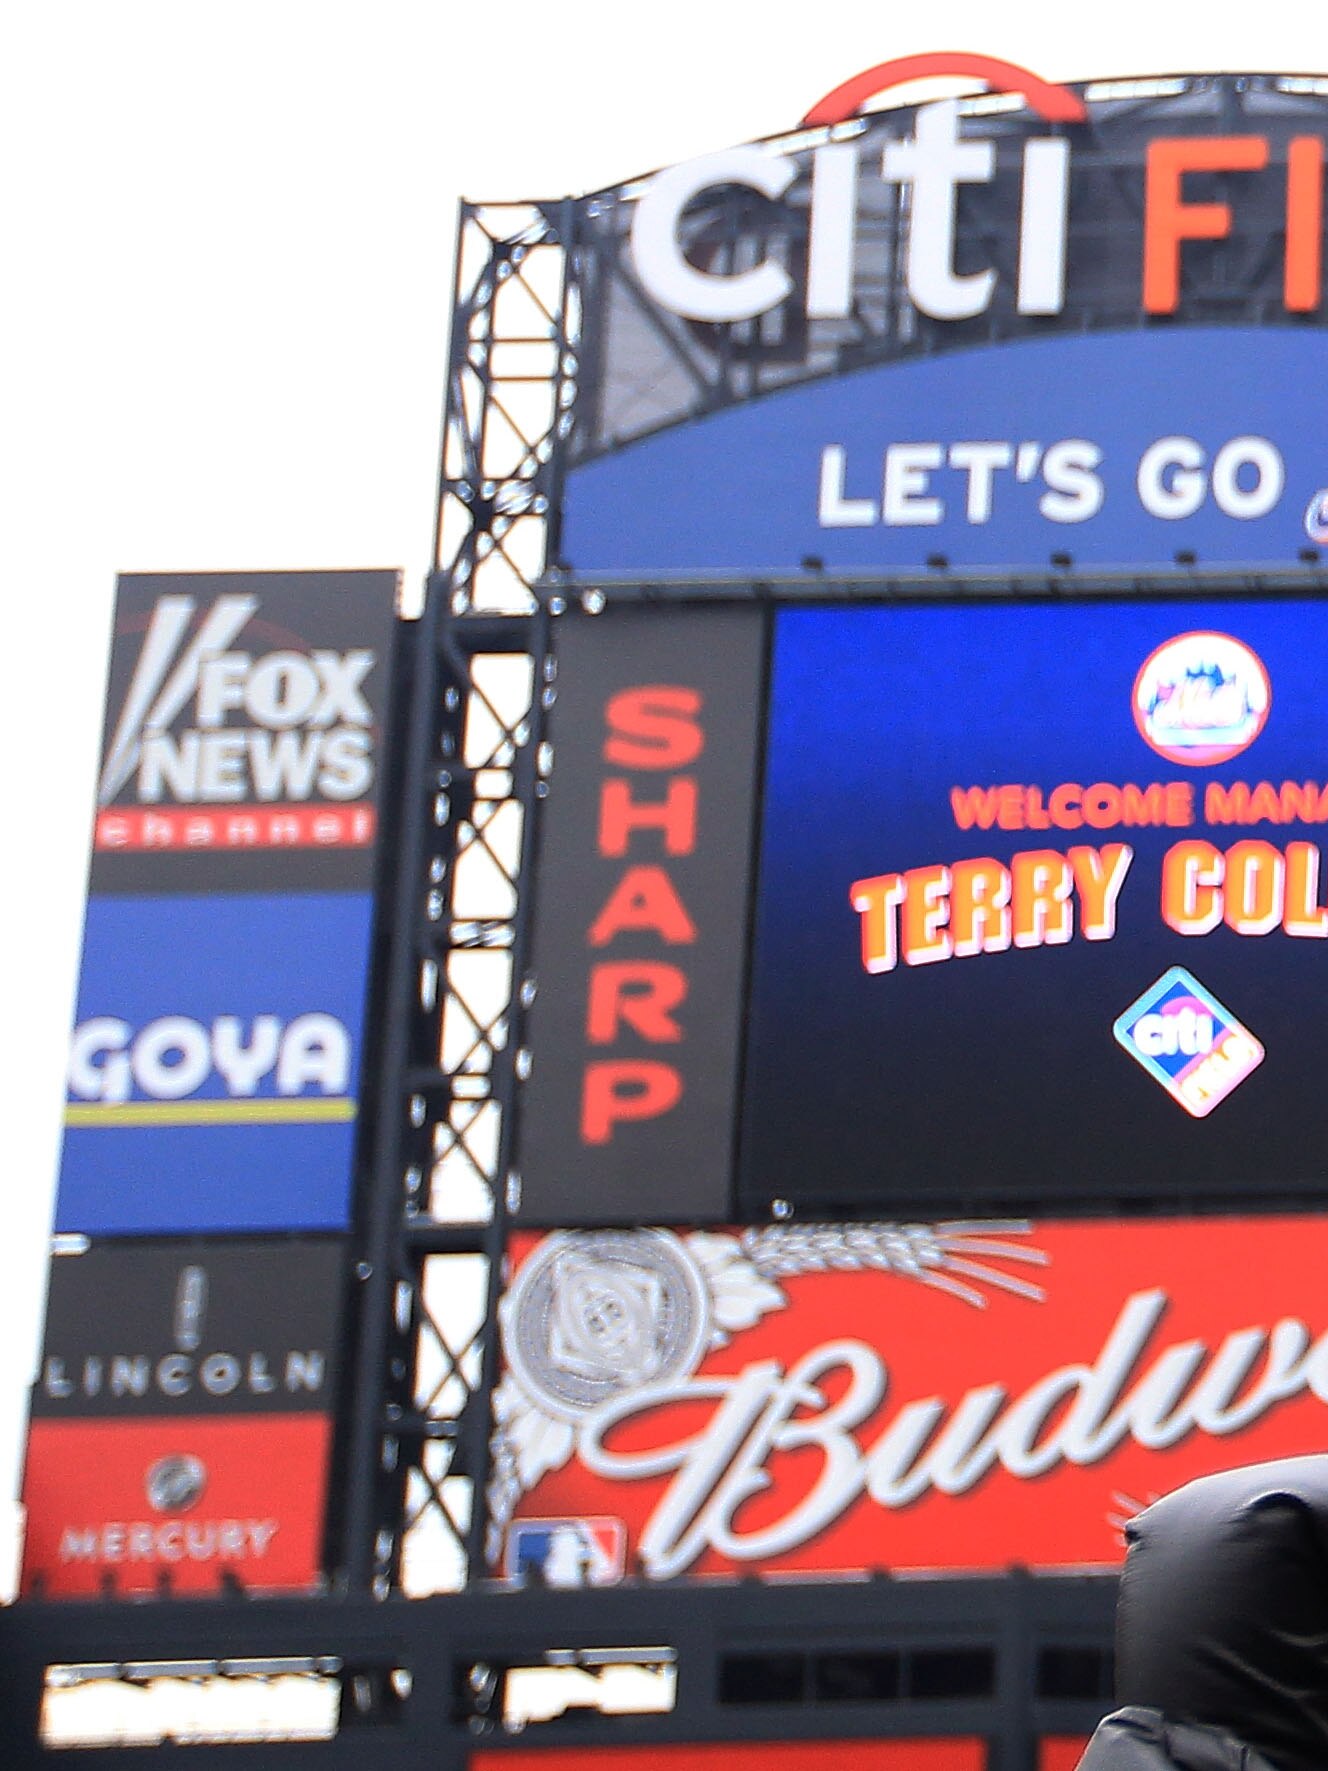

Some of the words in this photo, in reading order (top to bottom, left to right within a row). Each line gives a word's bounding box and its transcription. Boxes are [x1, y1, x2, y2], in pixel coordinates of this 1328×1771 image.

[818, 438, 1105, 528] LET'S
[1136, 435, 1286, 521] GO
[196, 648, 377, 730] FOX
[137, 727, 375, 803] NEWS
[101, 811, 373, 848] channel
[951, 782, 1193, 831] WELCOME
[580, 684, 706, 1147] SHARP
[850, 842, 1134, 975] TERRY
[66, 1011, 353, 1106] GOYA
[42, 1350, 327, 1398] LINCOLN
[59, 1518, 280, 1563] MERCURY
